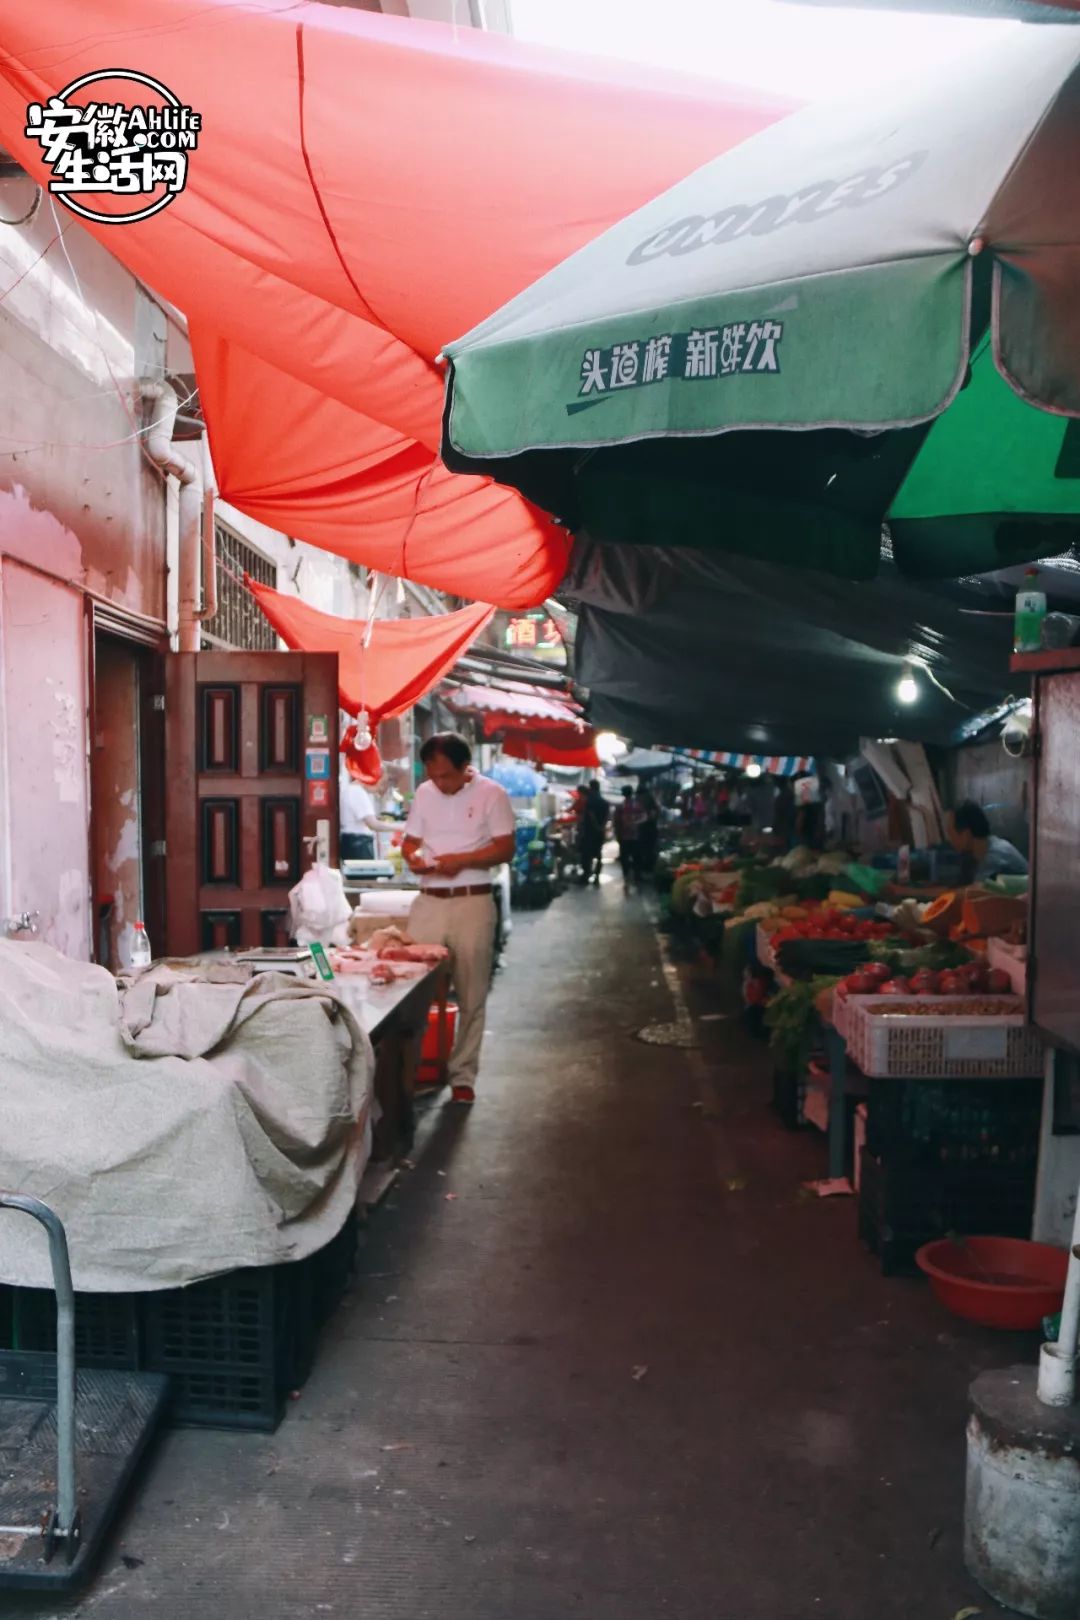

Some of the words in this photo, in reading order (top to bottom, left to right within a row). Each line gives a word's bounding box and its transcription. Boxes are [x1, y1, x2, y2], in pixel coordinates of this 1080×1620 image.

[581, 334, 672, 394] 头道榨
[684, 320, 783, 377] 新鲜饮
